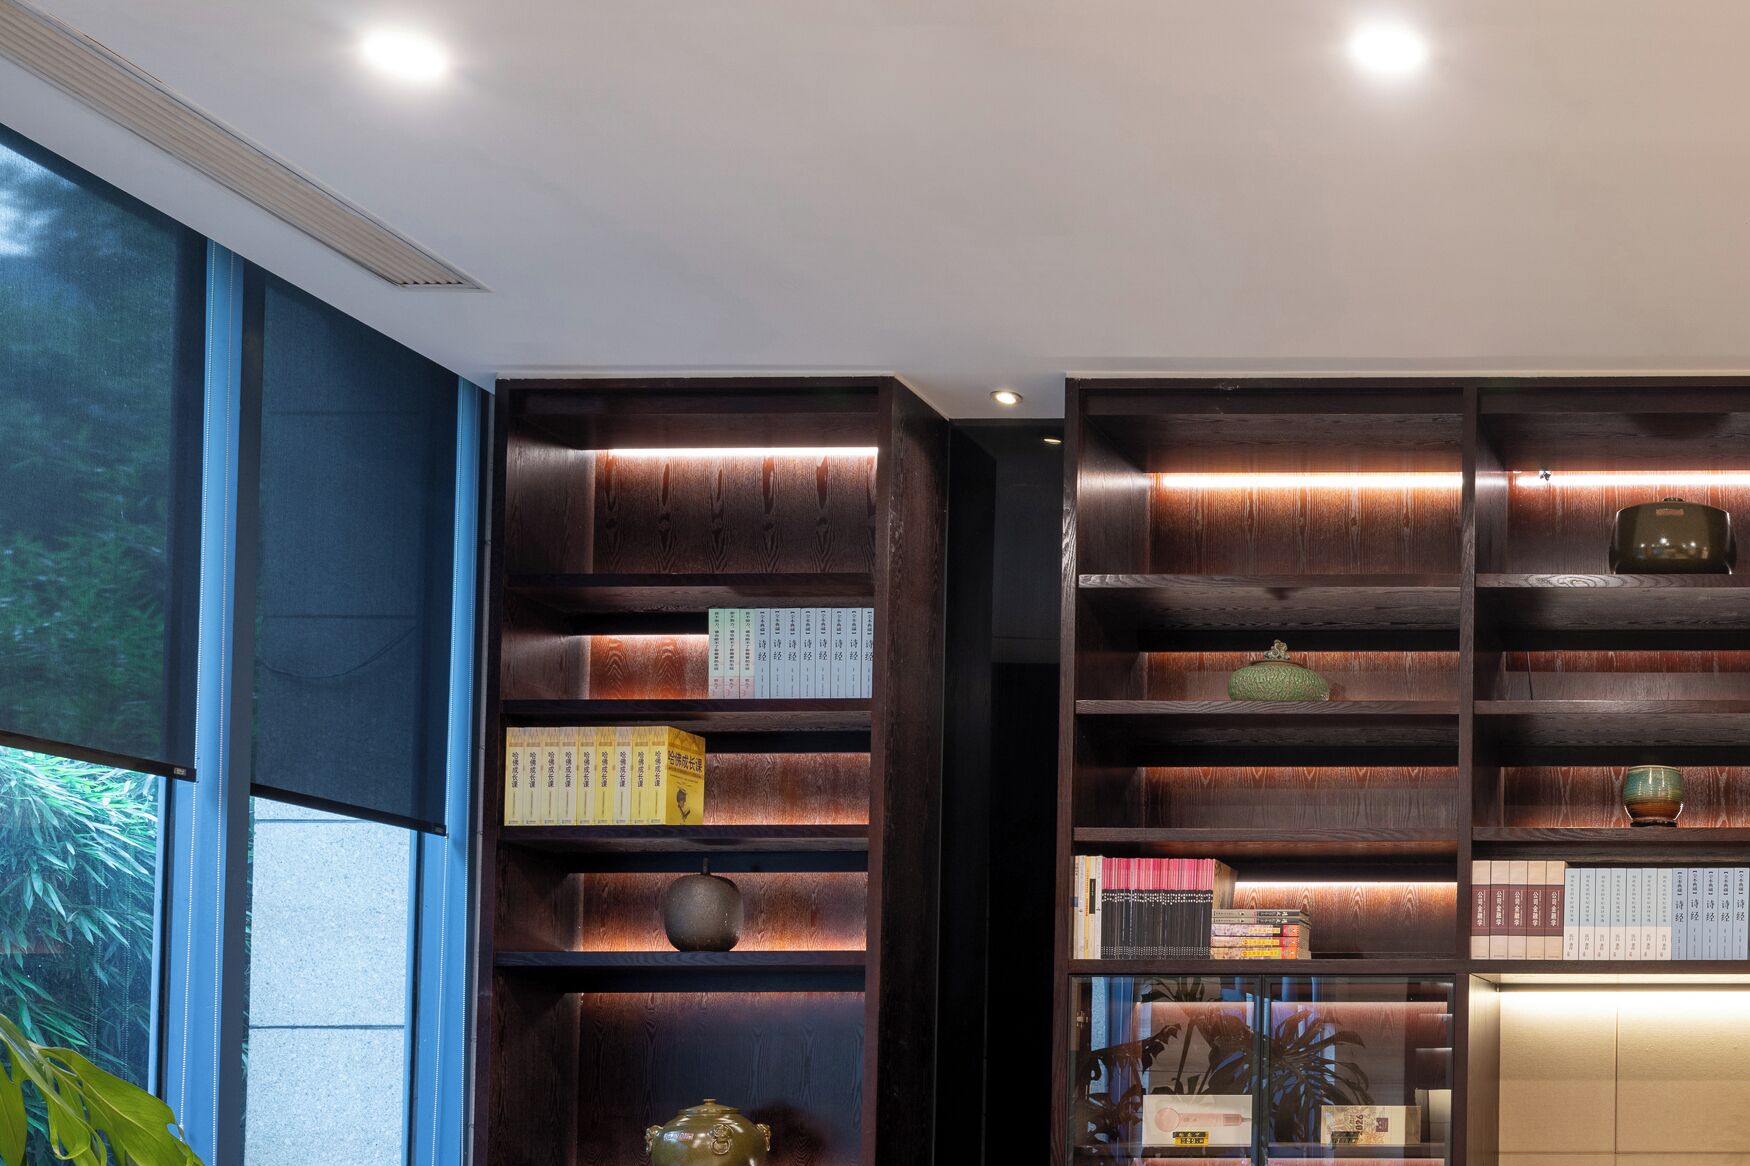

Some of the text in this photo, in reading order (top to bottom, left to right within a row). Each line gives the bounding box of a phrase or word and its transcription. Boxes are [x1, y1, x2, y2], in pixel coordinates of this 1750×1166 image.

[758, 639, 766, 661] 诗经
[774, 639, 781, 661] 诗经
[788, 640, 797, 661] 诗经
[804, 639, 812, 661] 诗经
[819, 639, 827, 661] 诗经
[835, 639, 843, 661] 诗经
[850, 639, 858, 661] 诗经
[668, 752, 702, 773] 哈佛成长课
[1675, 900, 1684, 922] 诗经
[1690, 899, 1699, 921] 诗经
[1706, 900, 1715, 922] 诗经
[1721, 900, 1730, 922] 诗经
[1736, 899, 1745, 921] 诗经
